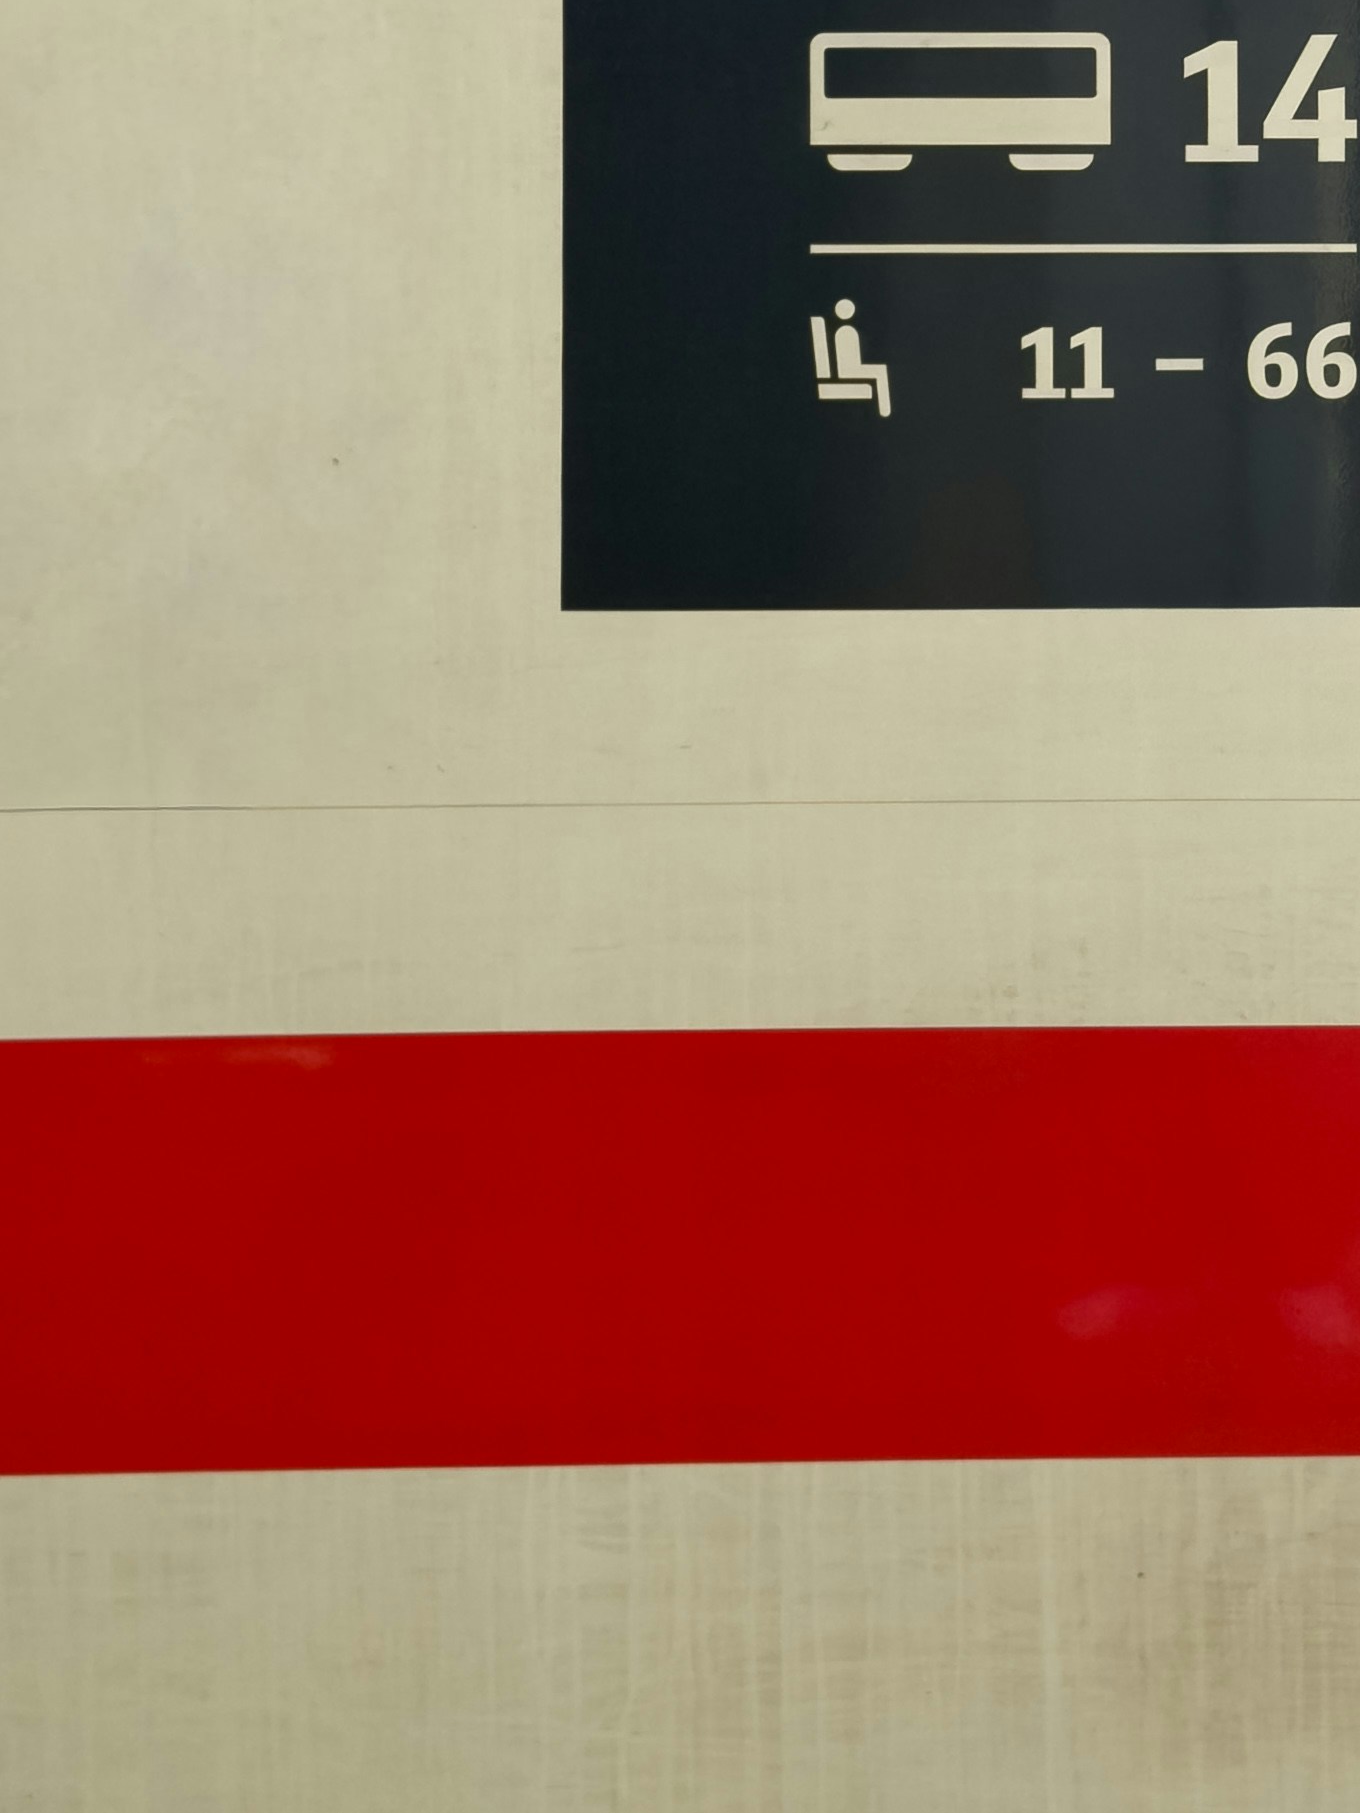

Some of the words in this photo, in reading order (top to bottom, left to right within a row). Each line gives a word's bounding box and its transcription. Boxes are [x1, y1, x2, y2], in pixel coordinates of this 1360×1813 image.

[1182, 34, 1359, 164] 14
[1020, 326, 1116, 400] 11
[1246, 321, 1359, 400] 66
